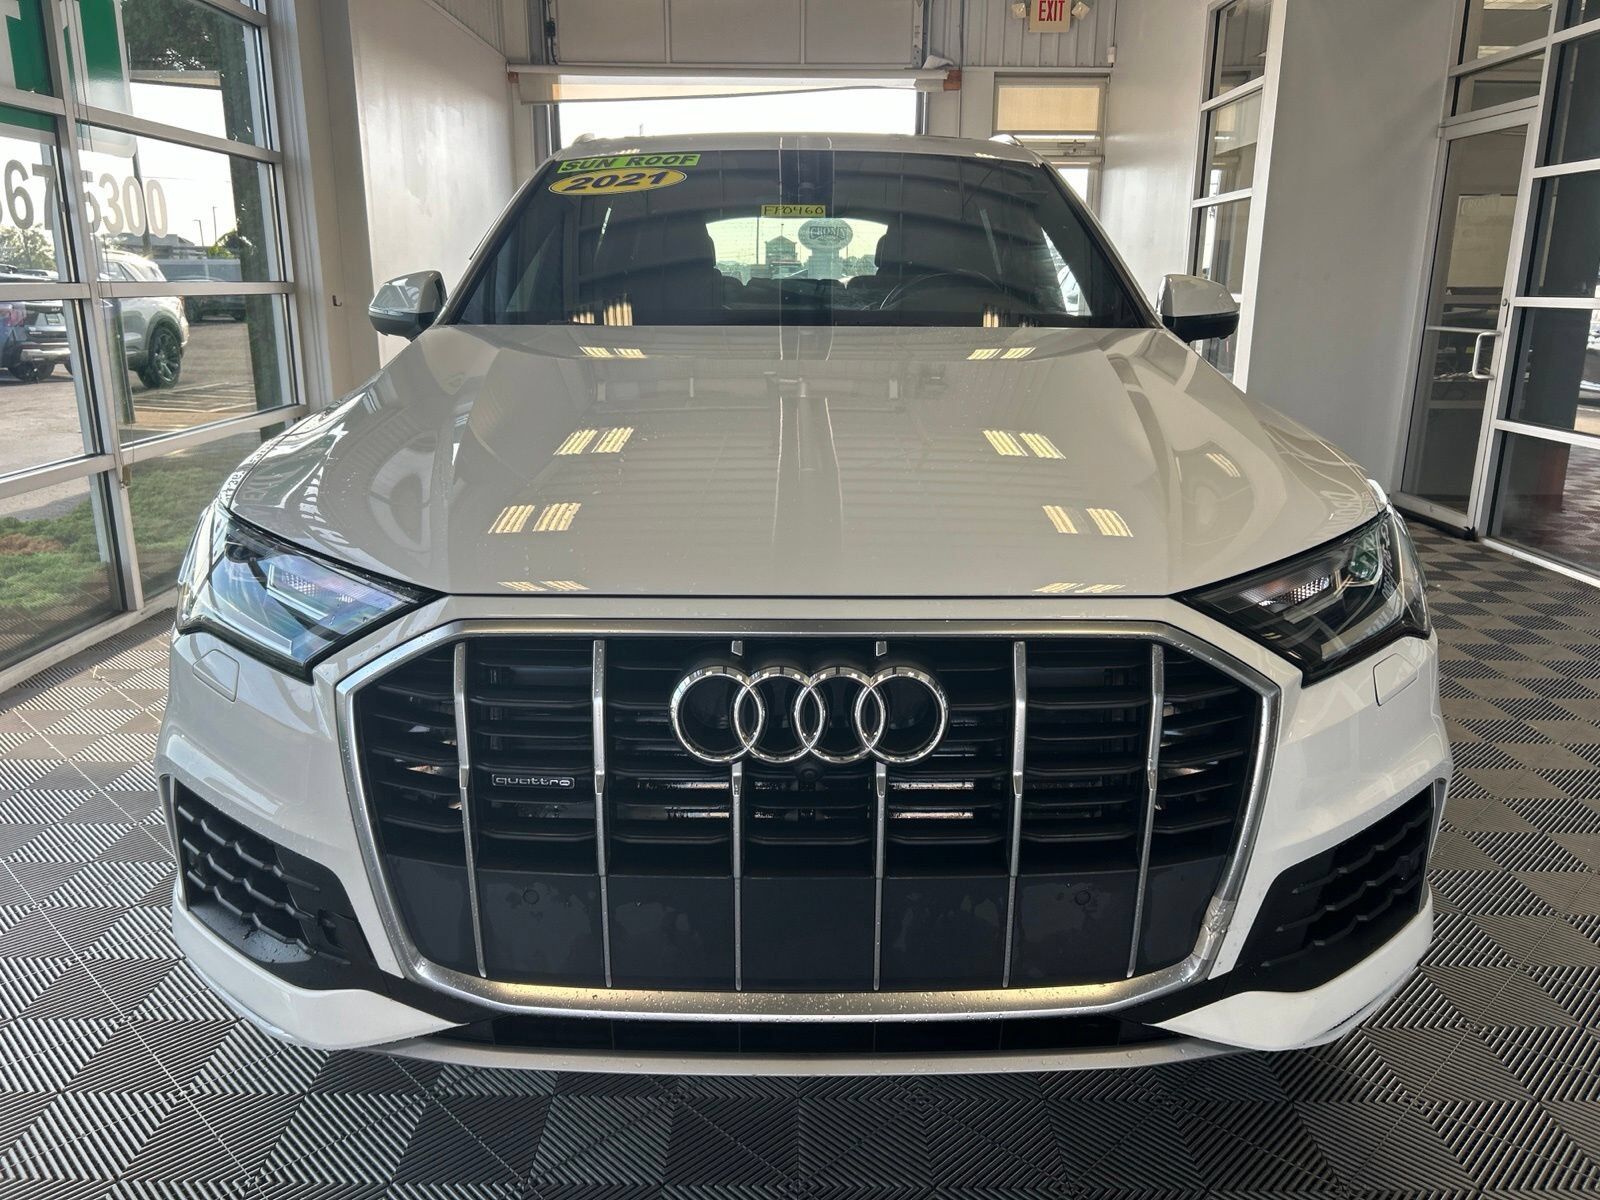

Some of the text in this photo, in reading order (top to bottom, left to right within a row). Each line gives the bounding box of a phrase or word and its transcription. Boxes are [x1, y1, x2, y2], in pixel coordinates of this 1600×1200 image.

[1039, 1, 1065, 21] EXIT
[564, 154, 698, 171] SUN ROOF
[561, 171, 669, 191] 2021
[0, 160, 57, 231] 67
[495, 777, 571, 788] quattro
